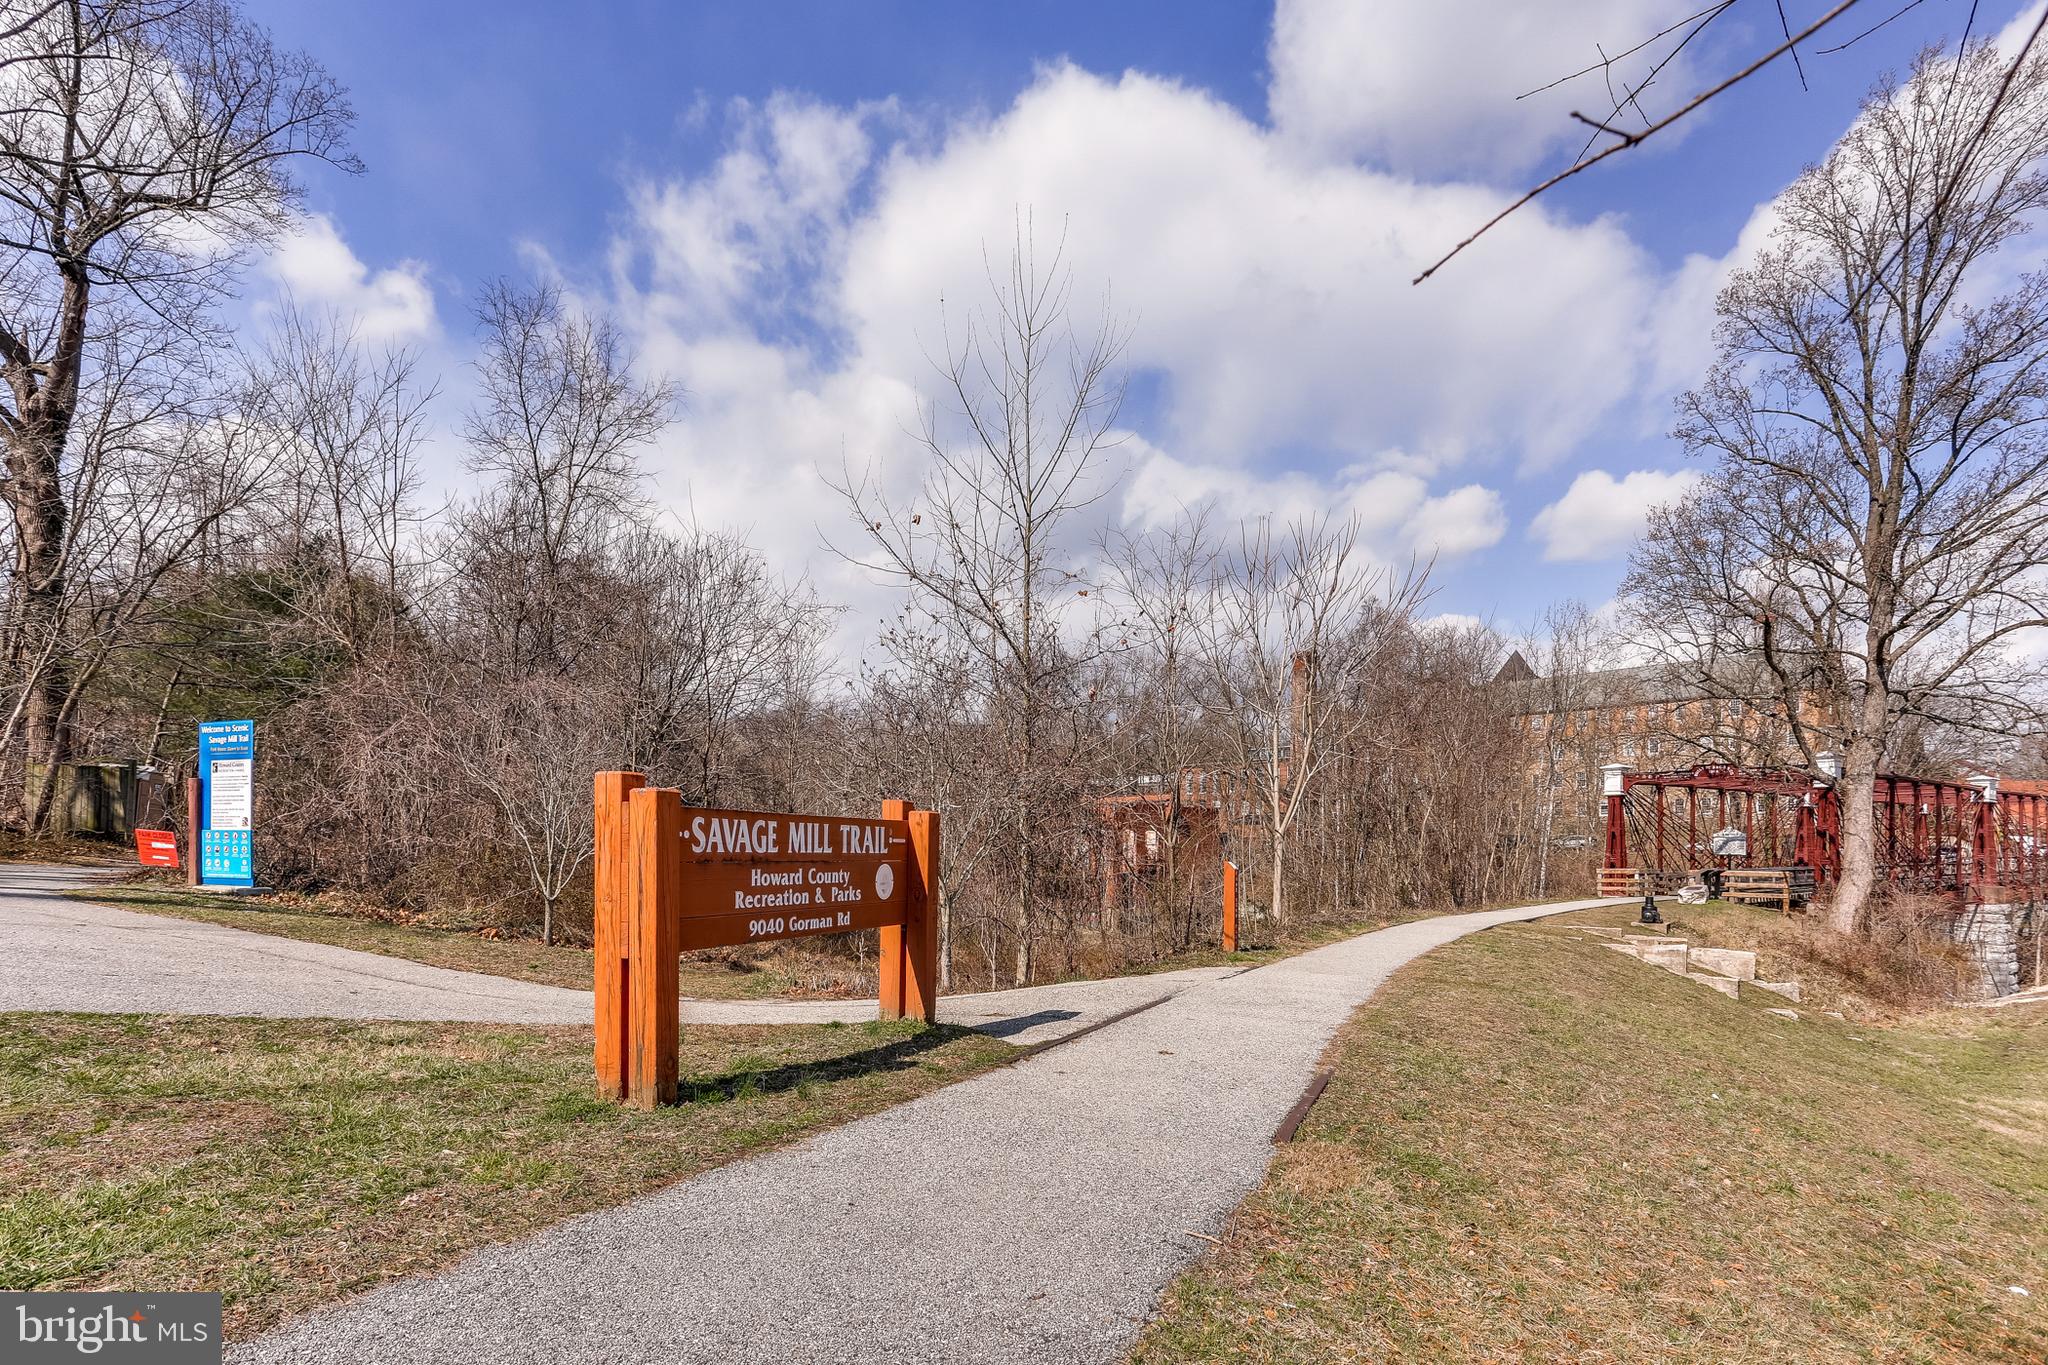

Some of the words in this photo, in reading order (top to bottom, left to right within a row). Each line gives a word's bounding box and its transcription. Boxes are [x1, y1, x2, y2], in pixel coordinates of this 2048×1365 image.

[232, 724, 249, 732] Scenic
[209, 736, 227, 744] Savage
[692, 816, 779, 853] SAVAGE
[788, 821, 832, 853] MILL
[840, 824, 888, 854] TRAIL
[751, 868, 803, 887] Howard
[808, 867, 850, 887] County
[735, 889, 809, 909] Recreation
[815, 887, 825, 903] &
[831, 887, 862, 902] Parks
[749, 917, 784, 937] 9040
[788, 916, 832, 932] Gorman
[837, 911, 850, 926] Rd
